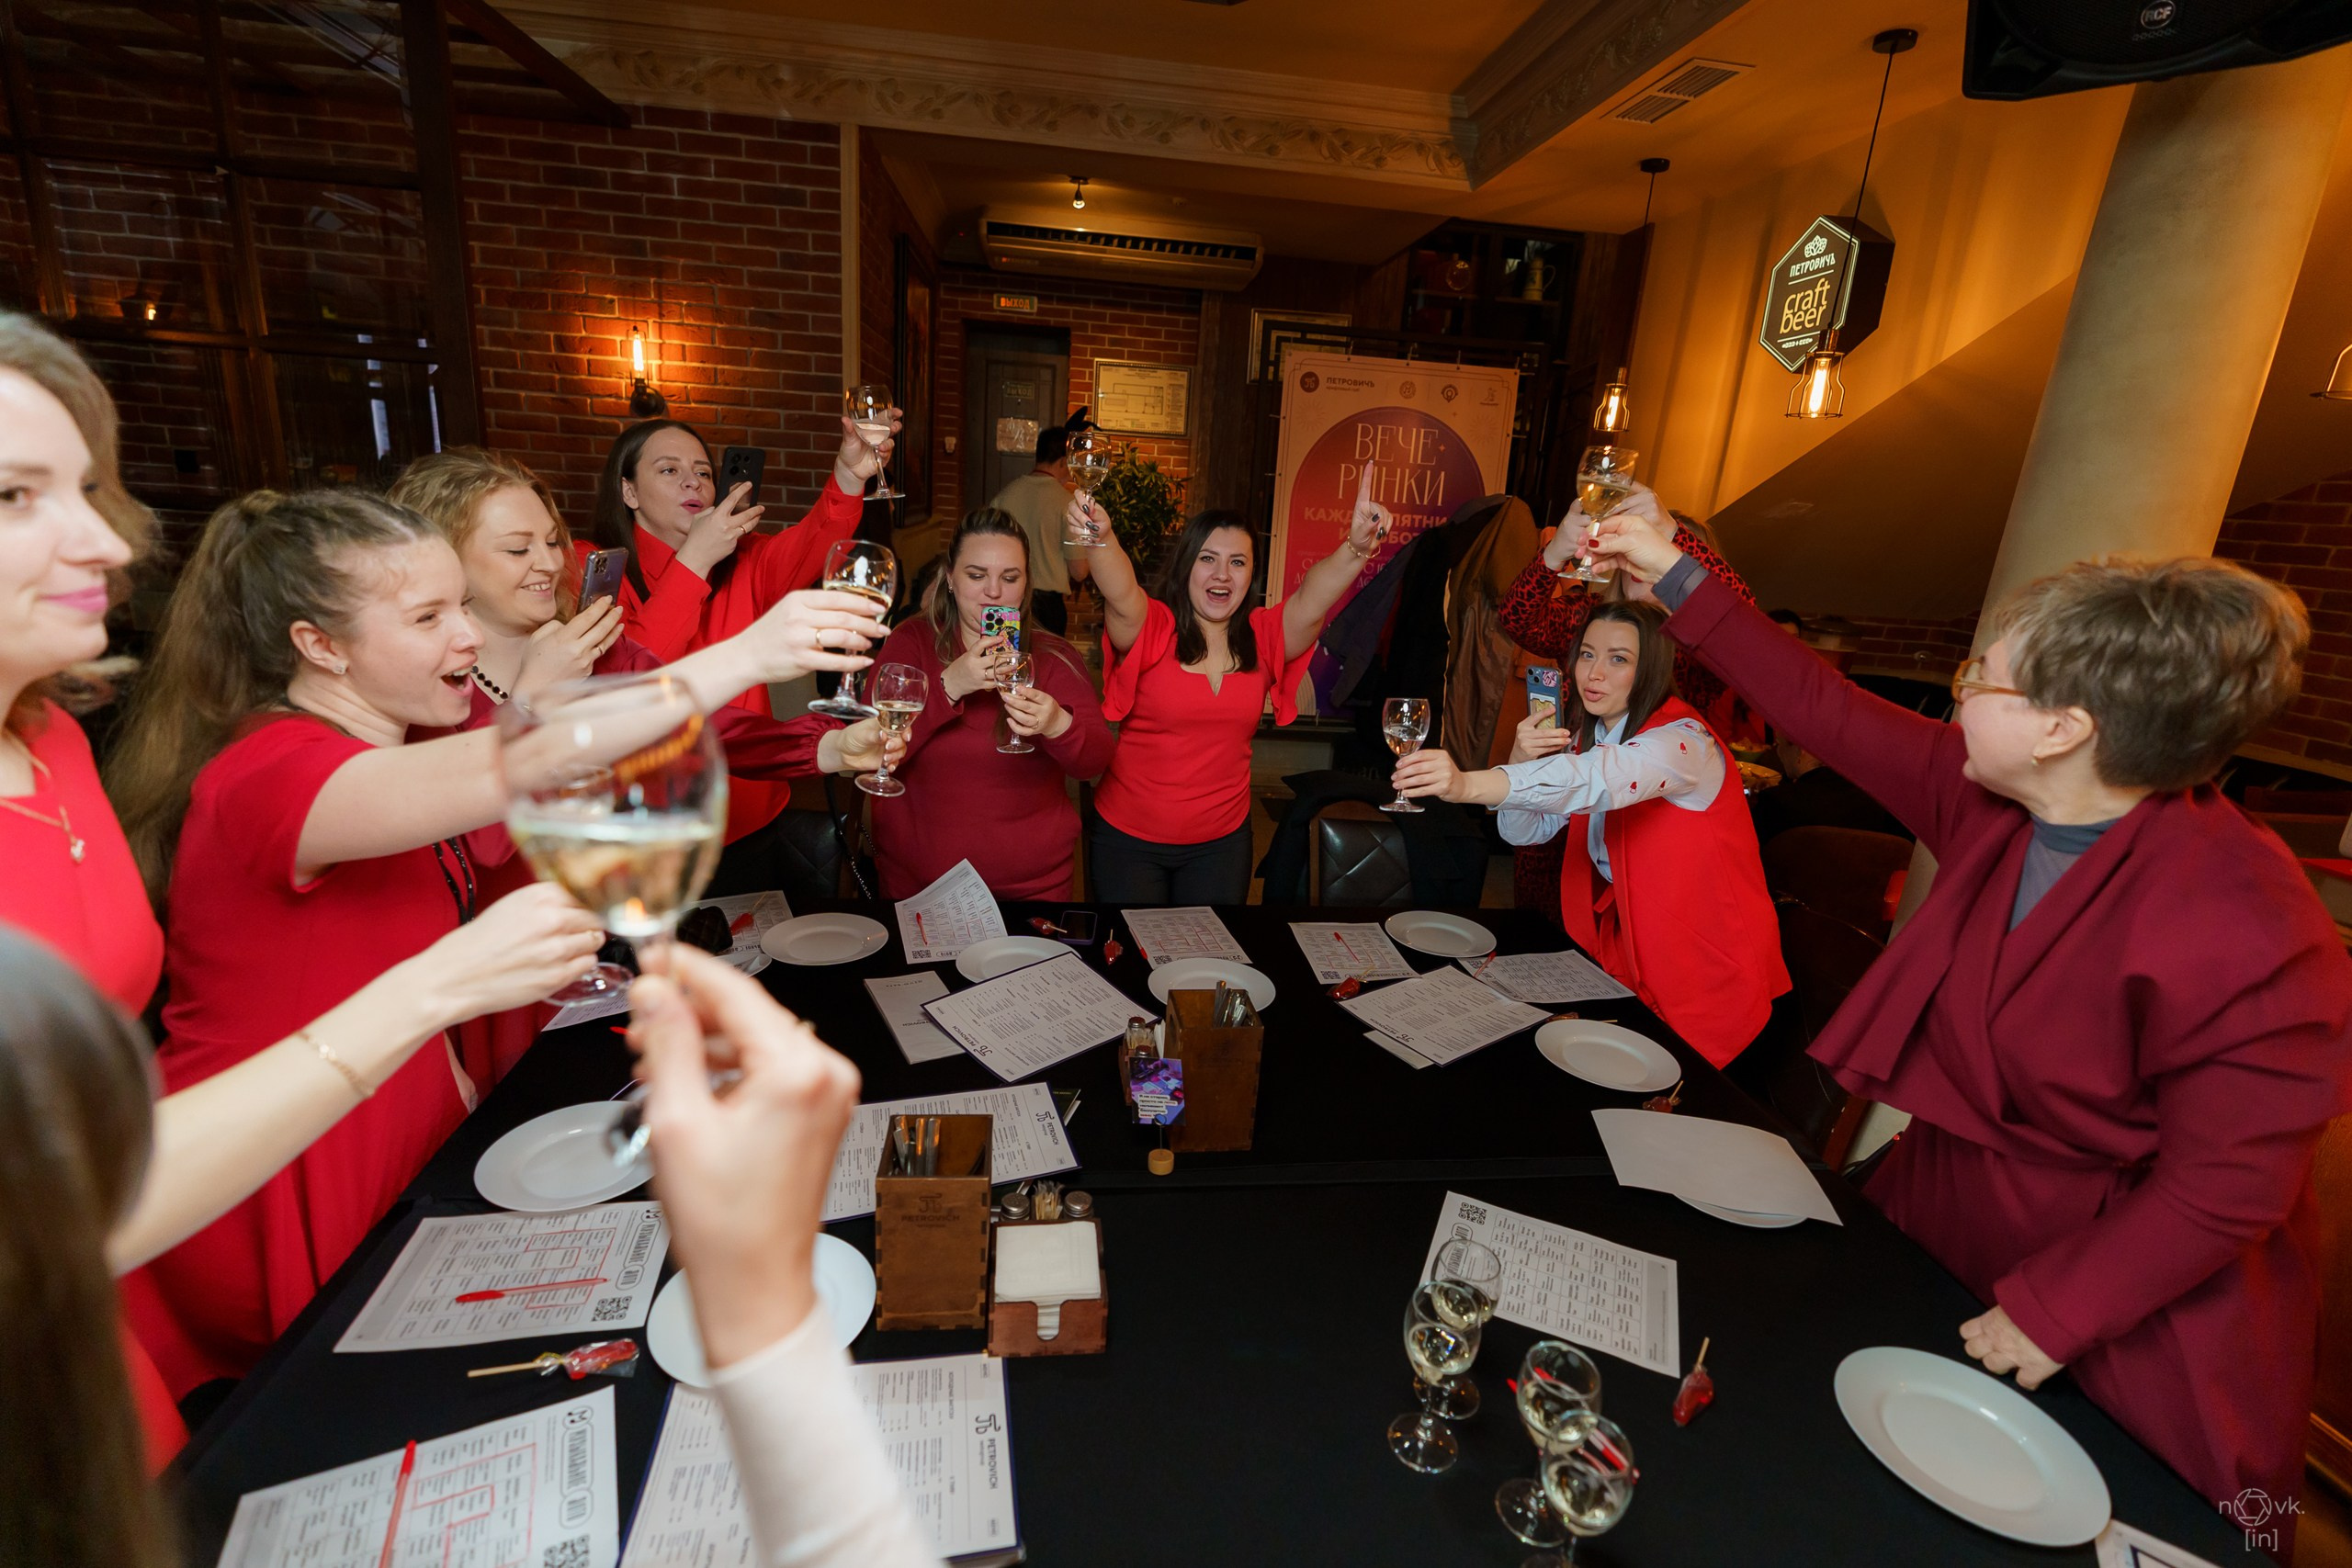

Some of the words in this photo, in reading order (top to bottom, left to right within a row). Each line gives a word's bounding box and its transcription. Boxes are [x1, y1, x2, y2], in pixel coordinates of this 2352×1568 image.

[2145, 6, 2173, 22] RCF
[1000, 296, 1031, 310] ВЫХОД
[1785, 277, 1831, 315] craft
[1779, 304, 1827, 334] beer
[1326, 377, 1375, 389] ПЕТРОВИЧЪ
[1354, 423, 1439, 466] ВЕЧЕ
[900, 1213, 961, 1223] PETROVICH
[987, 1438, 998, 1490] PETROVICH
